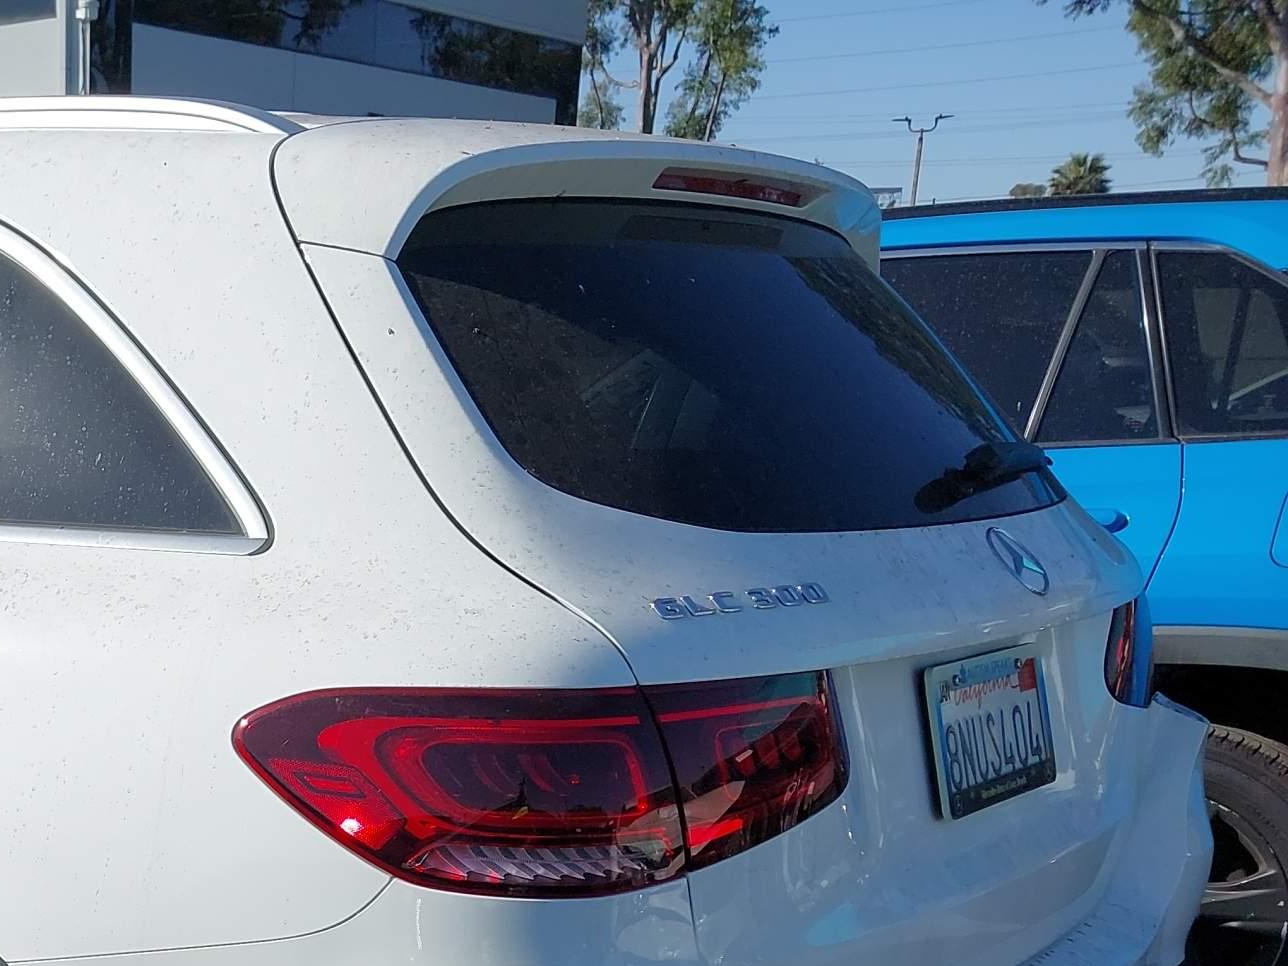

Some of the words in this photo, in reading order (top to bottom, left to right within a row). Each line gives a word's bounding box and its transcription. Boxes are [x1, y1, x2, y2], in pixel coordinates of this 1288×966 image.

[650, 591, 743, 620] GLC
[746, 582, 830, 609] 300
[954, 673, 1016, 709] California
[945, 701, 1040, 793] 8NUS404
